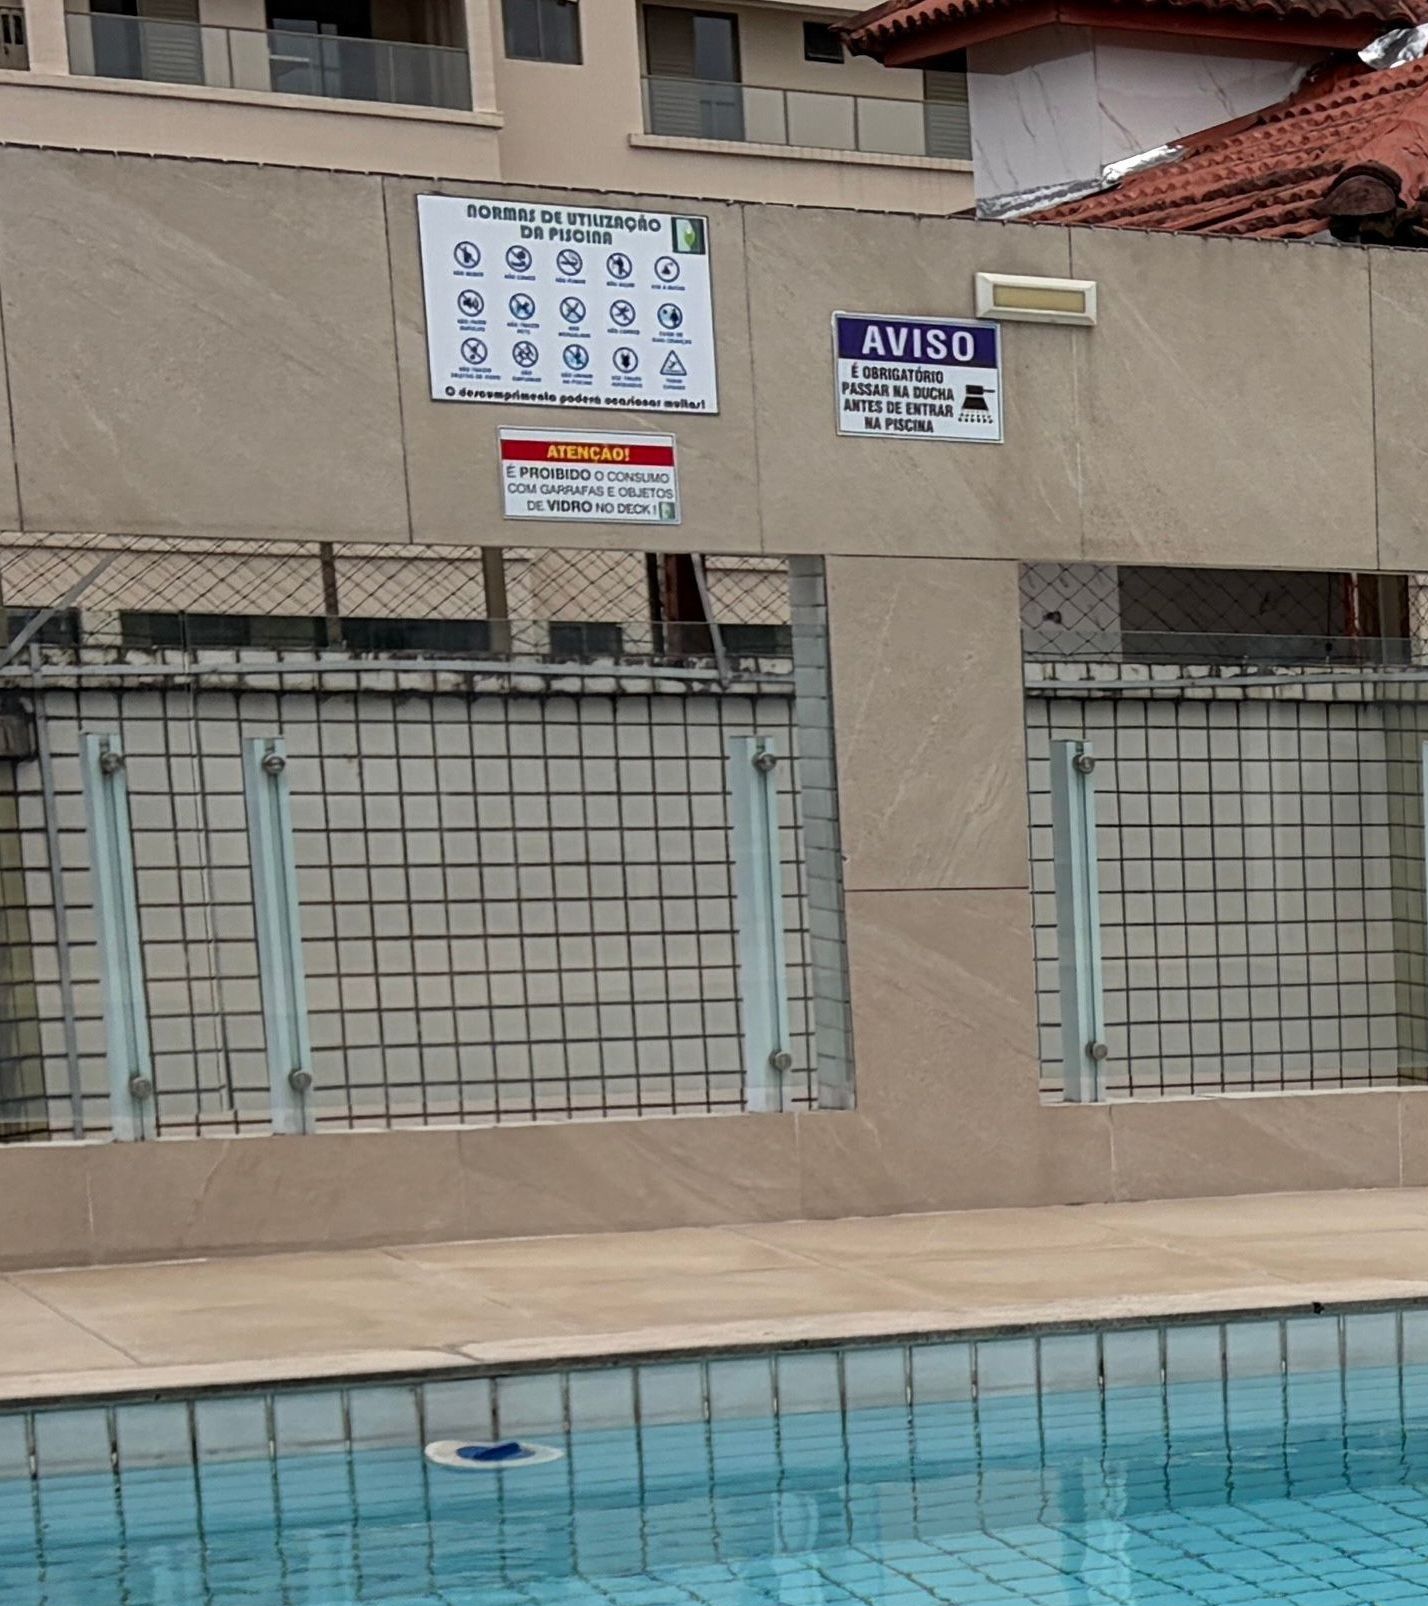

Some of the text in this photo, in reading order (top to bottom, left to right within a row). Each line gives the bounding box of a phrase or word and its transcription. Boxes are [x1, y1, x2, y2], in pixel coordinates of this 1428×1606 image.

[467, 204, 661, 232] NORMAS DE UTILIZAÇÃO
[520, 224, 613, 245] DA PISCINA
[862, 325, 975, 362] AVISO
[851, 362, 944, 384] É OBRIGATÓRIO
[842, 382, 955, 401] PASSAR NA DUCHA
[843, 400, 954, 417] ANTES DE ENTRAR
[865, 417, 934, 433] NA PISCINA
[547, 444, 630, 463] ATENÇÃO!
[506, 463, 670, 483] É PROIBIDO O CONSUMO
[507, 483, 674, 499] COM GARRAFAS E OBJETOS
[527, 500, 544, 512] DE
[547, 500, 592, 513] VIDRO
[596, 502, 614, 514] NO
